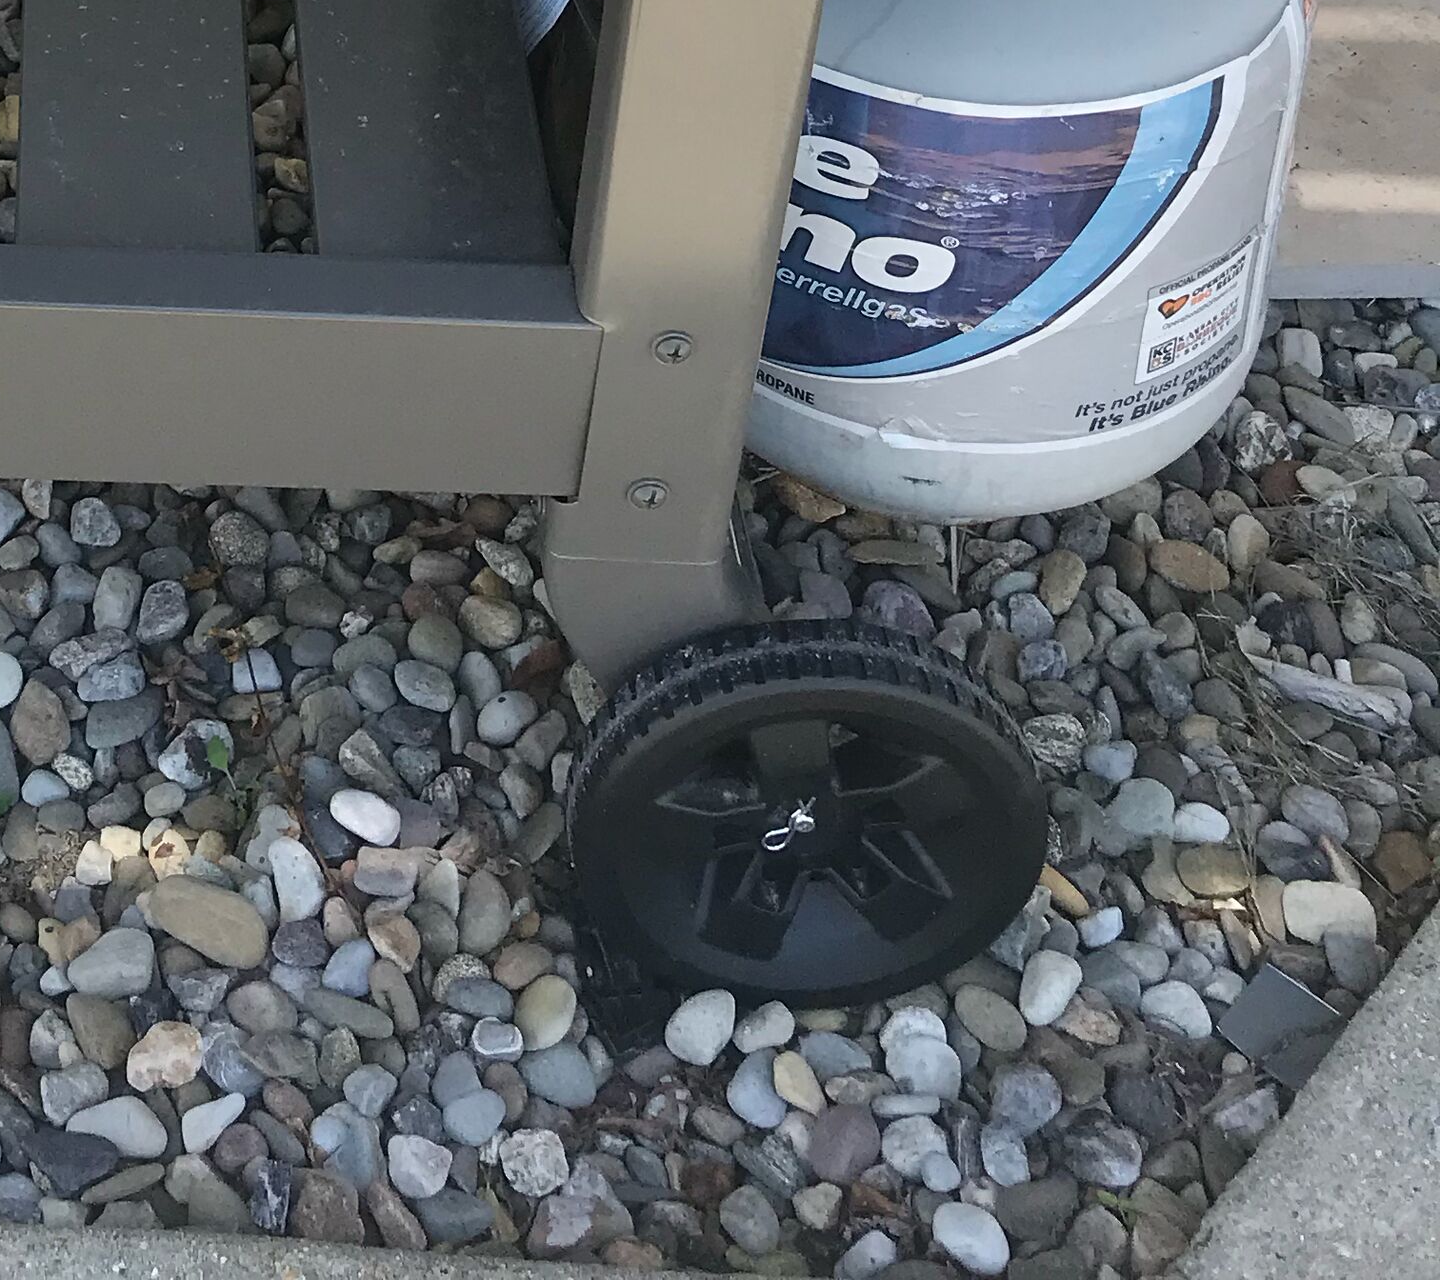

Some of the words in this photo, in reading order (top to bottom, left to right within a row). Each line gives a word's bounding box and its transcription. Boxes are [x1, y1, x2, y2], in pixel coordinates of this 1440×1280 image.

[776, 266, 931, 329] errellgas
[1159, 275, 1196, 295] OFFICIAL
[1075, 401, 1106, 418] It's
[1110, 390, 1144, 410] not
[1145, 374, 1180, 402] just
[1181, 334, 1240, 385] propane
[1088, 412, 1125, 433] It's
[1130, 393, 1179, 421] Blue
